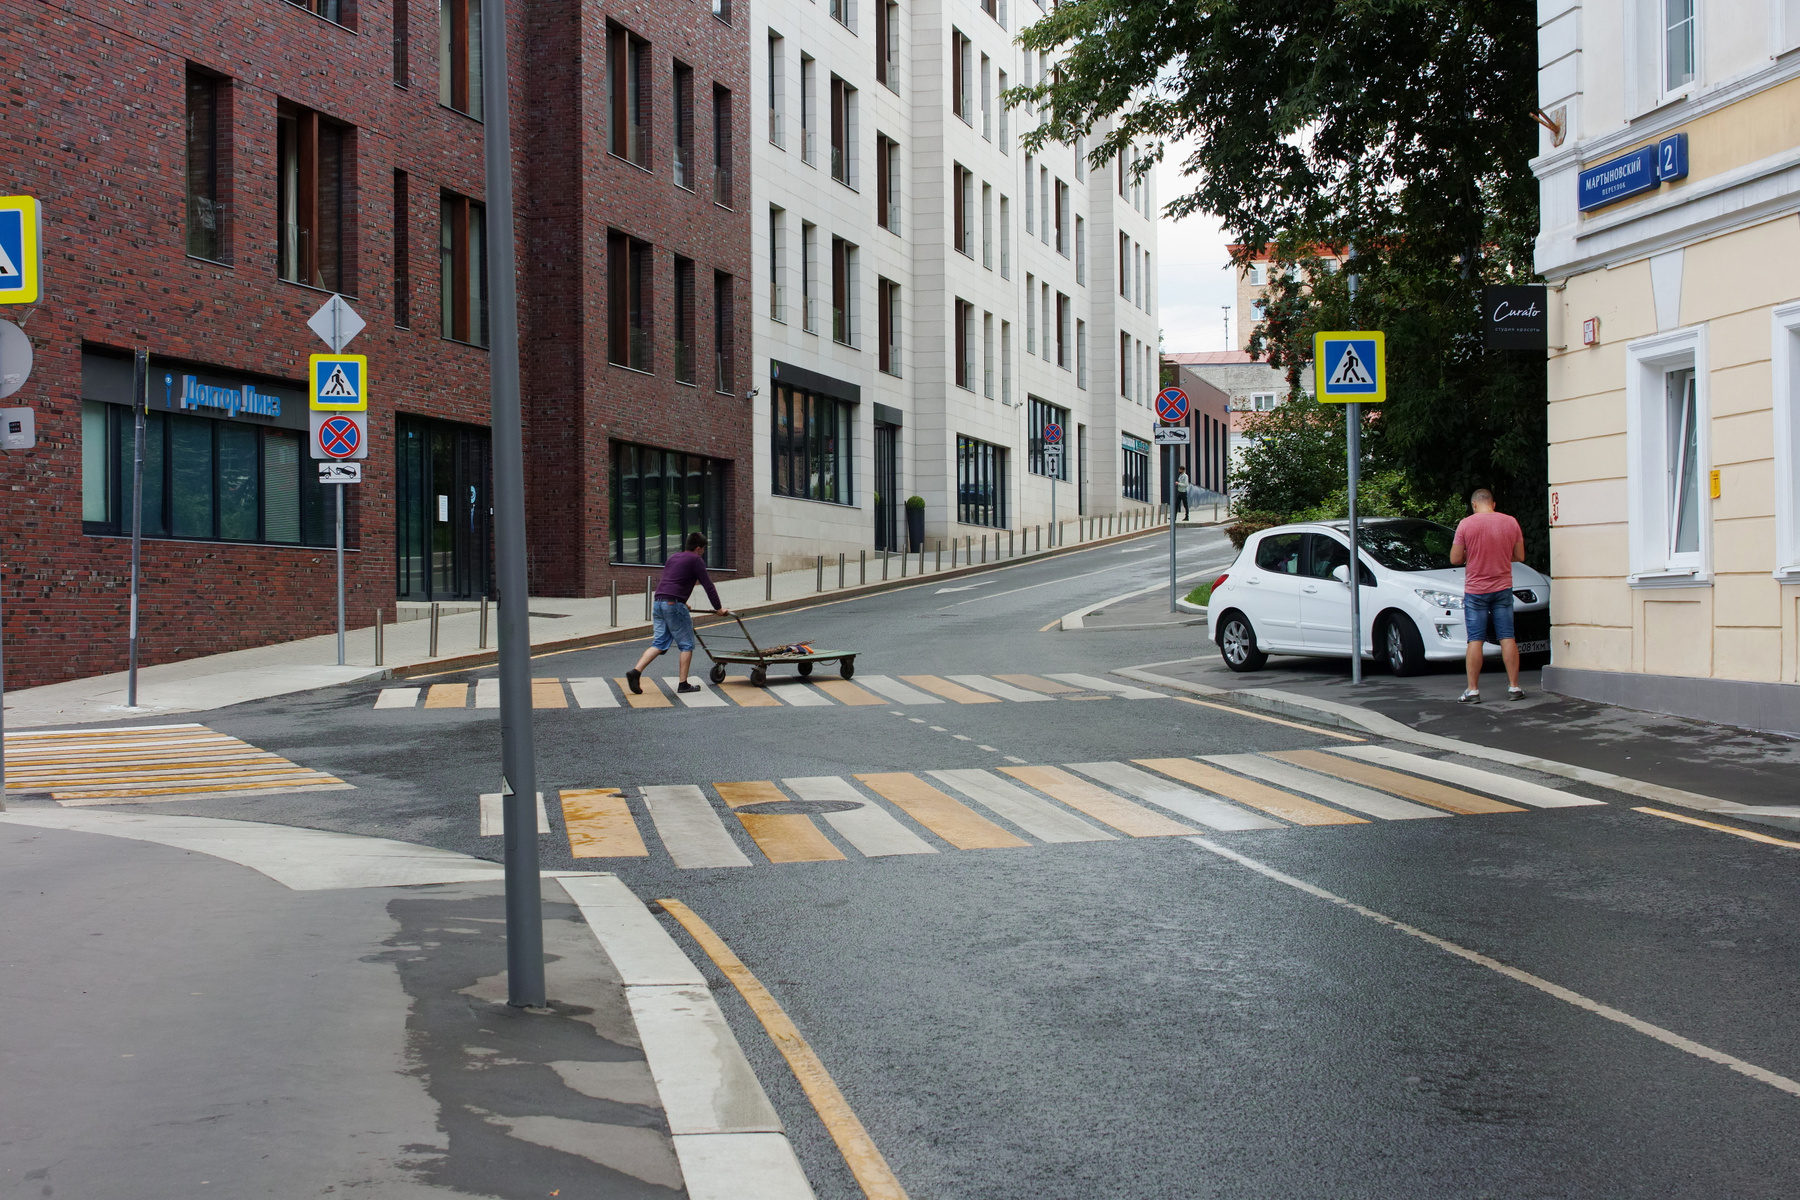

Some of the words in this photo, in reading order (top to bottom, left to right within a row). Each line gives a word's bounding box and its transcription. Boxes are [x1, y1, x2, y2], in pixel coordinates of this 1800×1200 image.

[1664, 144, 1673, 171] 2
[1585, 157, 1641, 191] МАРТЫНОВСКИЙ
[1601, 182, 1626, 195] ПЕРЕУЛОК
[1493, 301, 1541, 322] Curato
[181, 375, 242, 417] Доктор
[241, 385, 281, 417] Линз
